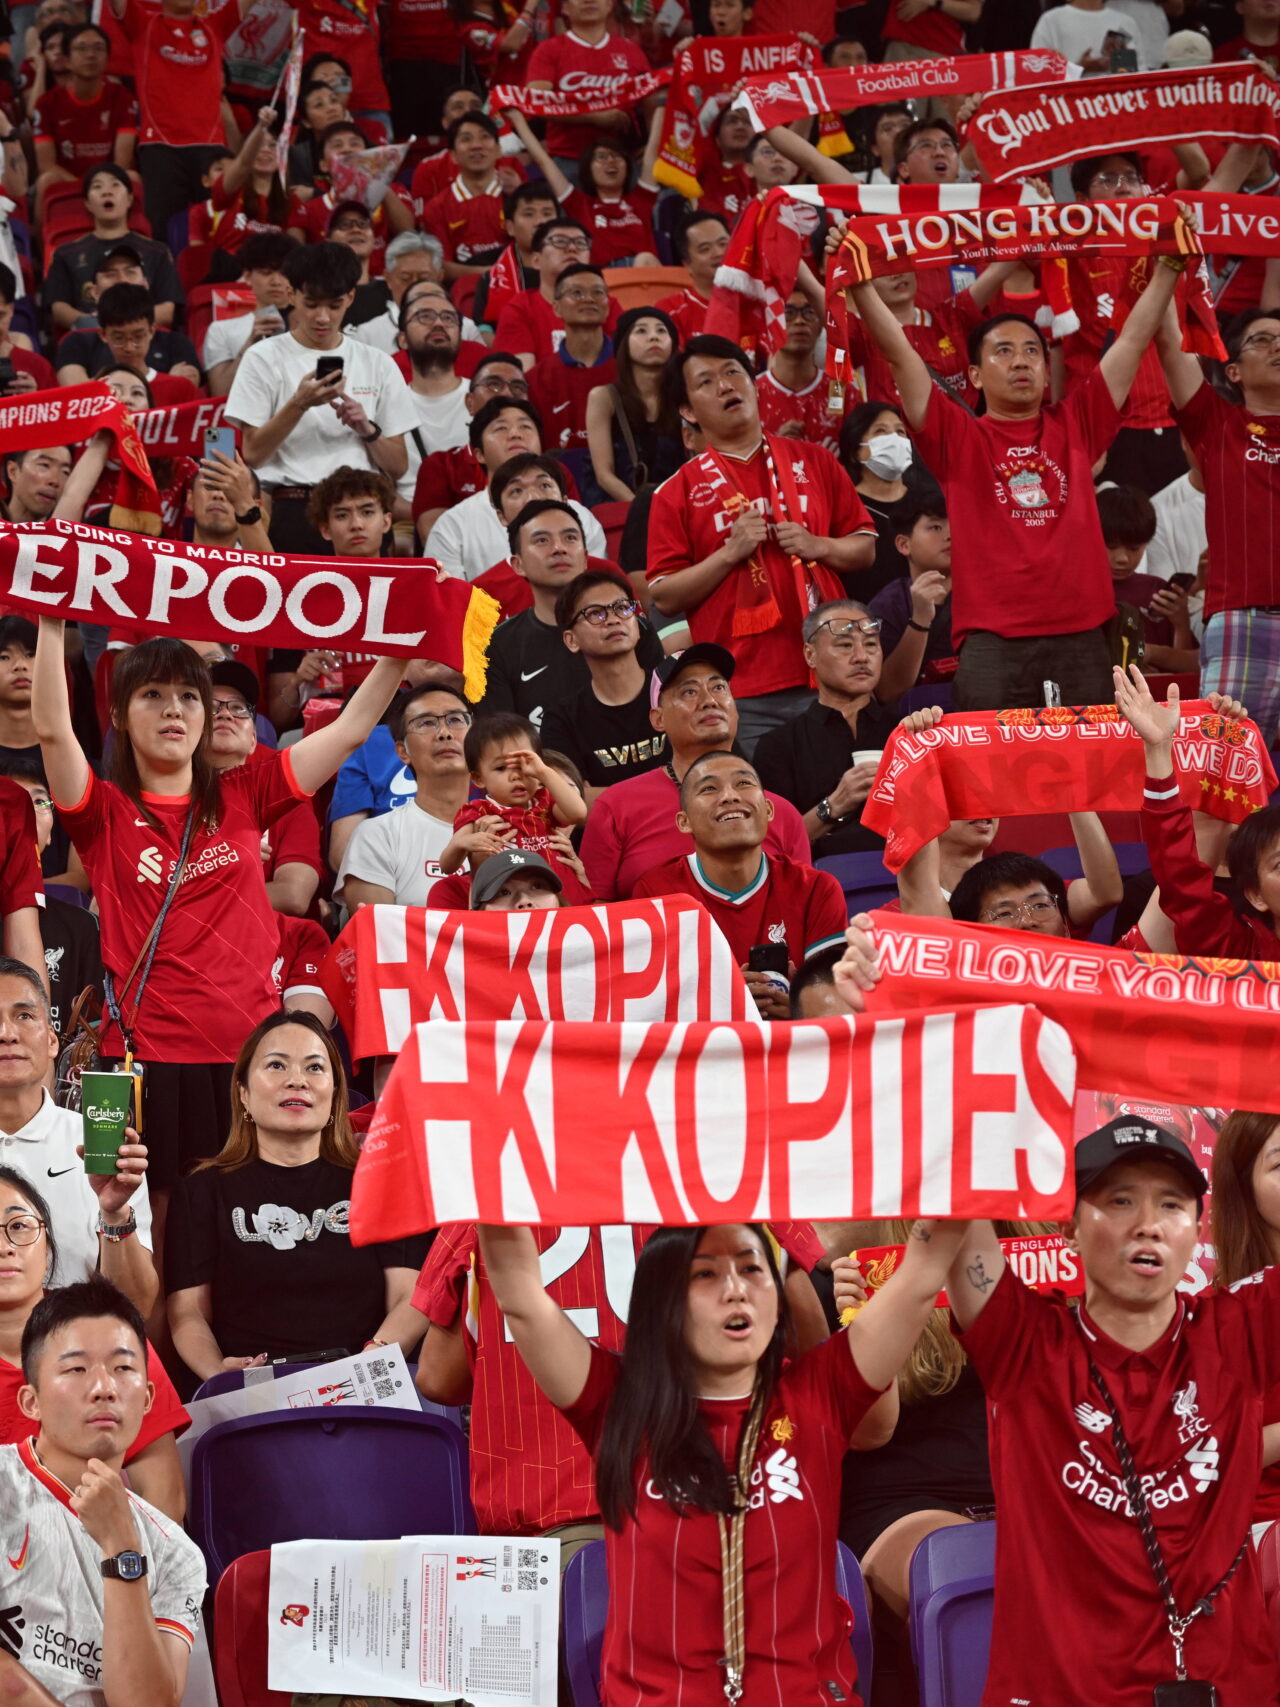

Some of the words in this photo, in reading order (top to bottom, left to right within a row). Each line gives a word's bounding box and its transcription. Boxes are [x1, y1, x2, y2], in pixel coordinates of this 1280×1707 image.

[704, 48, 725, 73] IS
[857, 70, 919, 94] Football
[922, 69, 959, 86] Club
[1075, 85, 1149, 120] never
[1155, 76, 1222, 109] walk
[876, 208, 1017, 262] HONG
[1029, 202, 1160, 241] KONG
[990, 245, 1020, 257] Never
[1021, 243, 1046, 253] Walk
[1047, 240, 1078, 252] Alone
[67, 395, 117, 419] 2025
[1012, 510, 1058, 518] ISTANBUL
[56, 518, 132, 546] GOING
[142, 538, 175, 553] TO
[187, 545, 286, 567] MADRID
[873, 751, 909, 805] WE
[896, 723, 991, 761] LOVE
[1174, 740, 1226, 777] WE
[1227, 747, 1262, 788] DO
[873, 928, 952, 979] WE
[957, 939, 1103, 995] LOVE
[1109, 959, 1227, 1004] YOU
[87, 1106, 124, 1122] Carlsberg
[1134, 1106, 1171, 1114] standard
[1012, 1238, 1067, 1250] ENGLAN
[33, 1644, 103, 1681] charter
